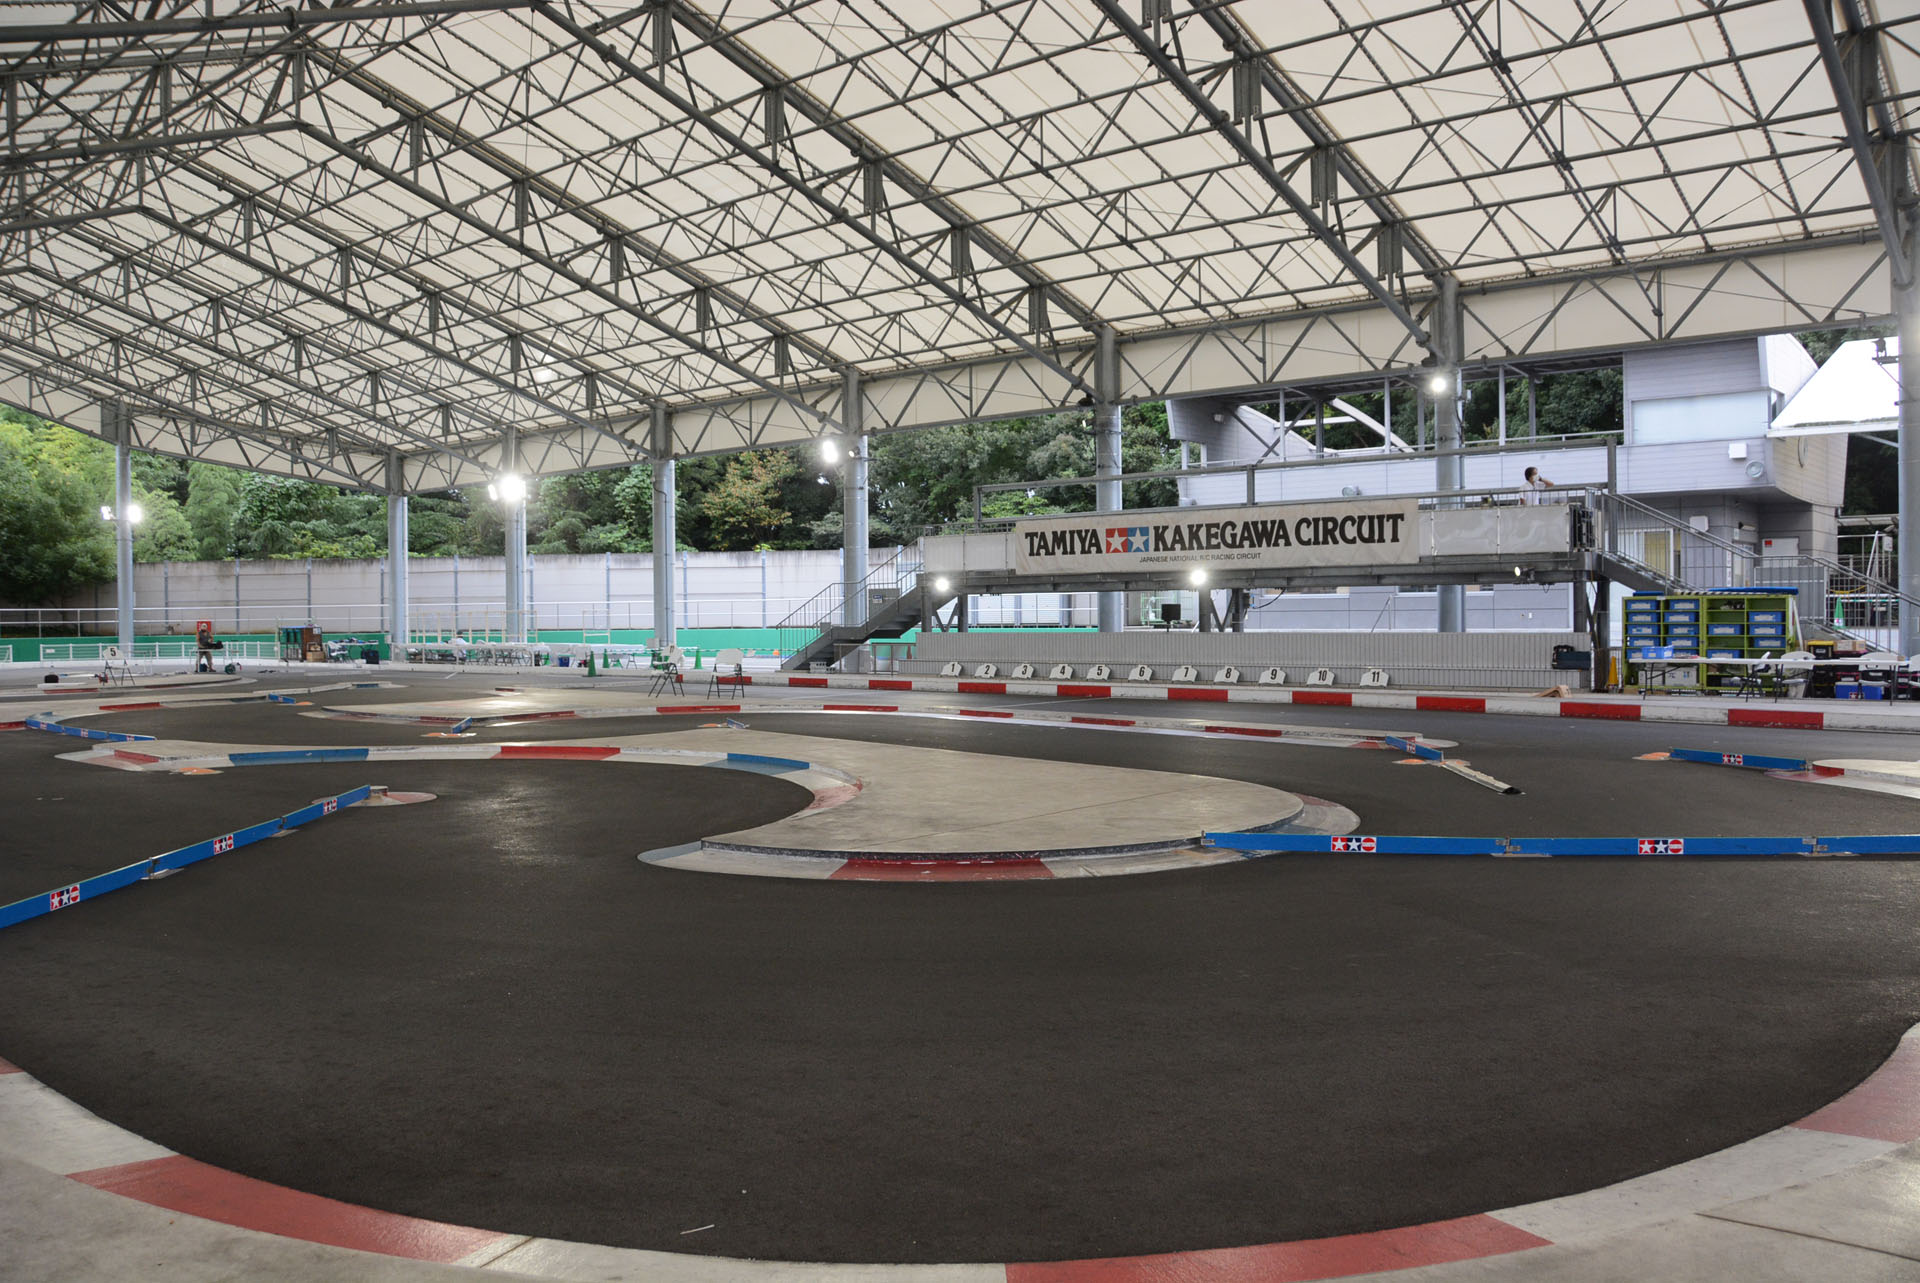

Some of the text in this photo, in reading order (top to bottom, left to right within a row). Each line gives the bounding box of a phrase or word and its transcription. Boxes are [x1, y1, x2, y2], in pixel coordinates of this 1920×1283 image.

[1025, 513, 1404, 556] TAMIYA KAKEGAWA CIRCUIT
[1139, 555, 1168, 563] JAPANESE
[1169, 554, 1198, 562] NATIONAL
[1211, 553, 1235, 561] RACING
[1236, 552, 1262, 560] CIRCUIT
[110, 647, 117, 657] 5
[984, 664, 991, 675] 2
[1021, 664, 1028, 675] 3
[1059, 665, 1066, 675] 4
[1096, 665, 1103, 676] 5
[1138, 666, 1145, 677] 6
[1184, 667, 1190, 677] 7
[1225, 667, 1232, 679] 8
[1270, 668, 1278, 680] 9
[1318, 669, 1328, 682] 10
[1371, 670, 1381, 683] 11
